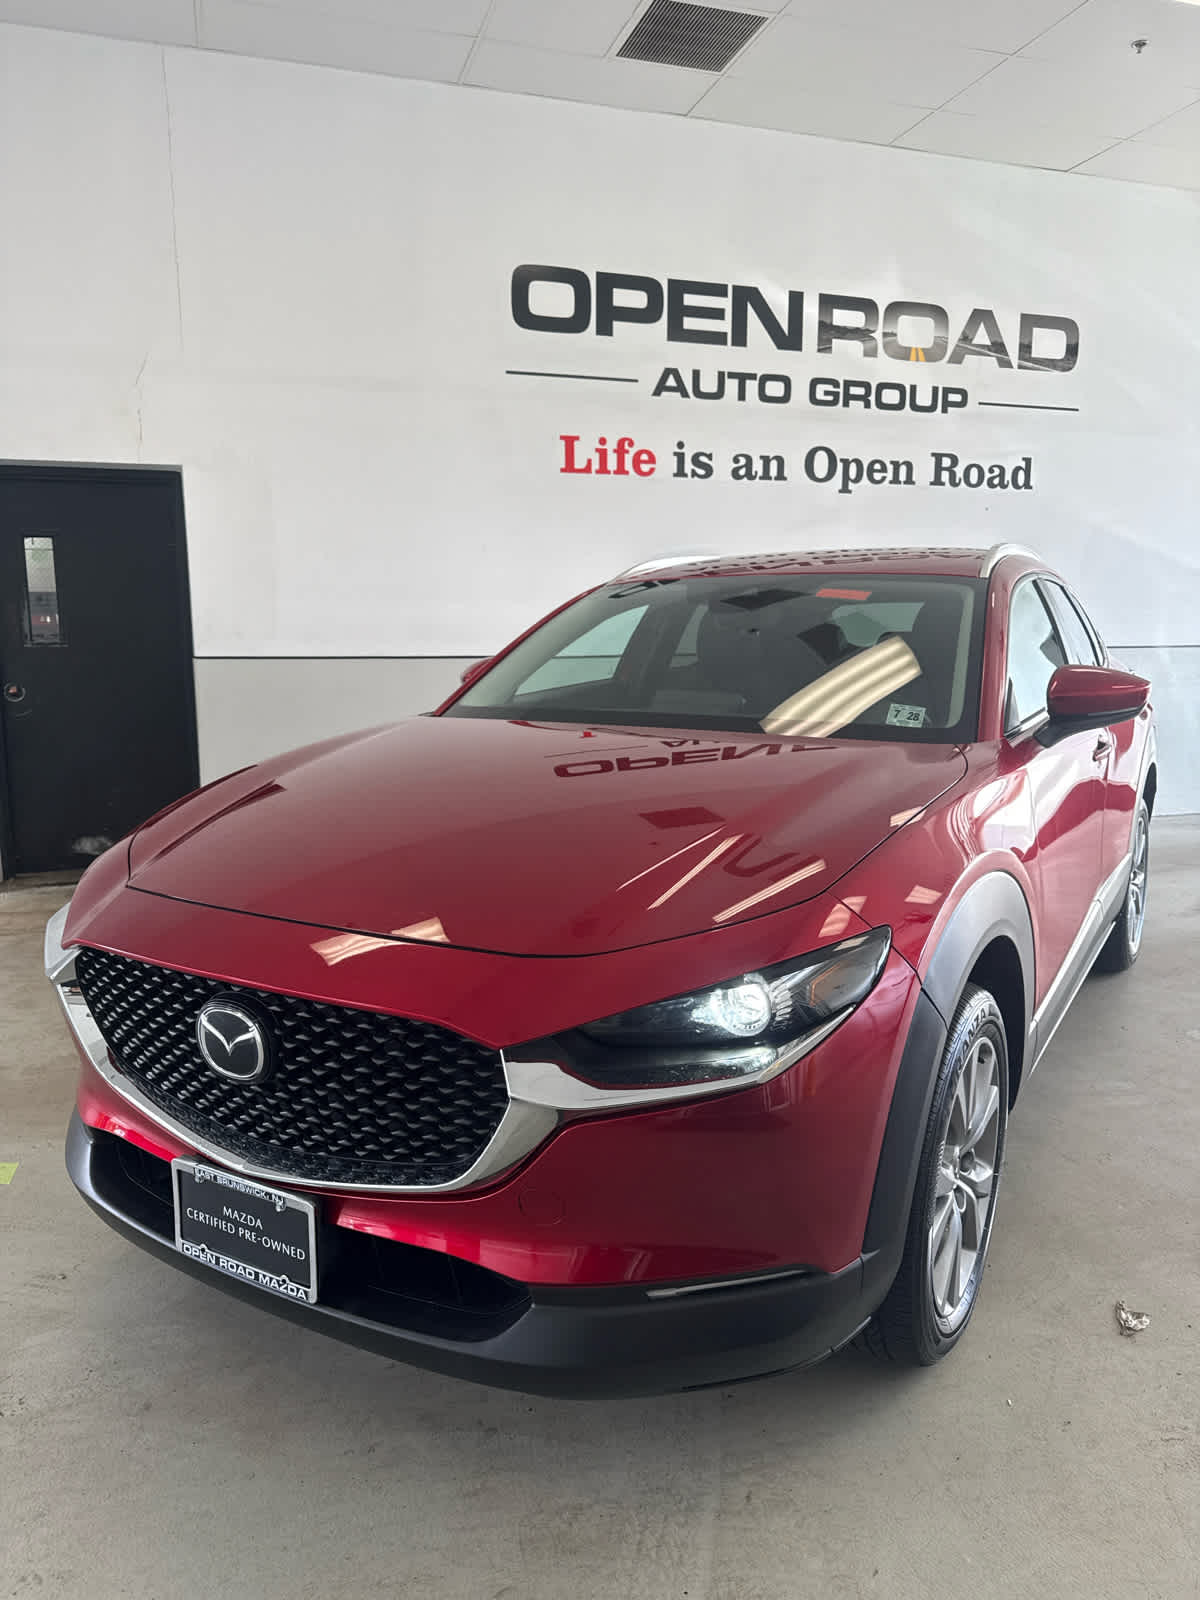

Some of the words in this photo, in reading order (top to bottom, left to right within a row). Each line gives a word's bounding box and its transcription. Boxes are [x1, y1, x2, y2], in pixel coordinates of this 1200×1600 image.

[511, 264, 803, 352] OPEN
[817, 292, 1080, 373] ROAD
[652, 367, 792, 404] AUTO
[808, 377, 968, 414] GROUP
[560, 435, 657, 477] Life
[672, 441, 714, 478] is
[730, 453, 787, 482] an
[804, 446, 916, 494] Open
[929, 452, 1033, 490] Road
[894, 709, 901, 719] 7
[186, 1207, 235, 1234] CERTIFIED
[238, 1226, 306, 1260] PRE-OWNED
[223, 1205, 263, 1230] MAZDA
[183, 1244, 216, 1265] OPEN
[219, 1258, 254, 1279] ROAD
[258, 1273, 307, 1300] MAZDA
